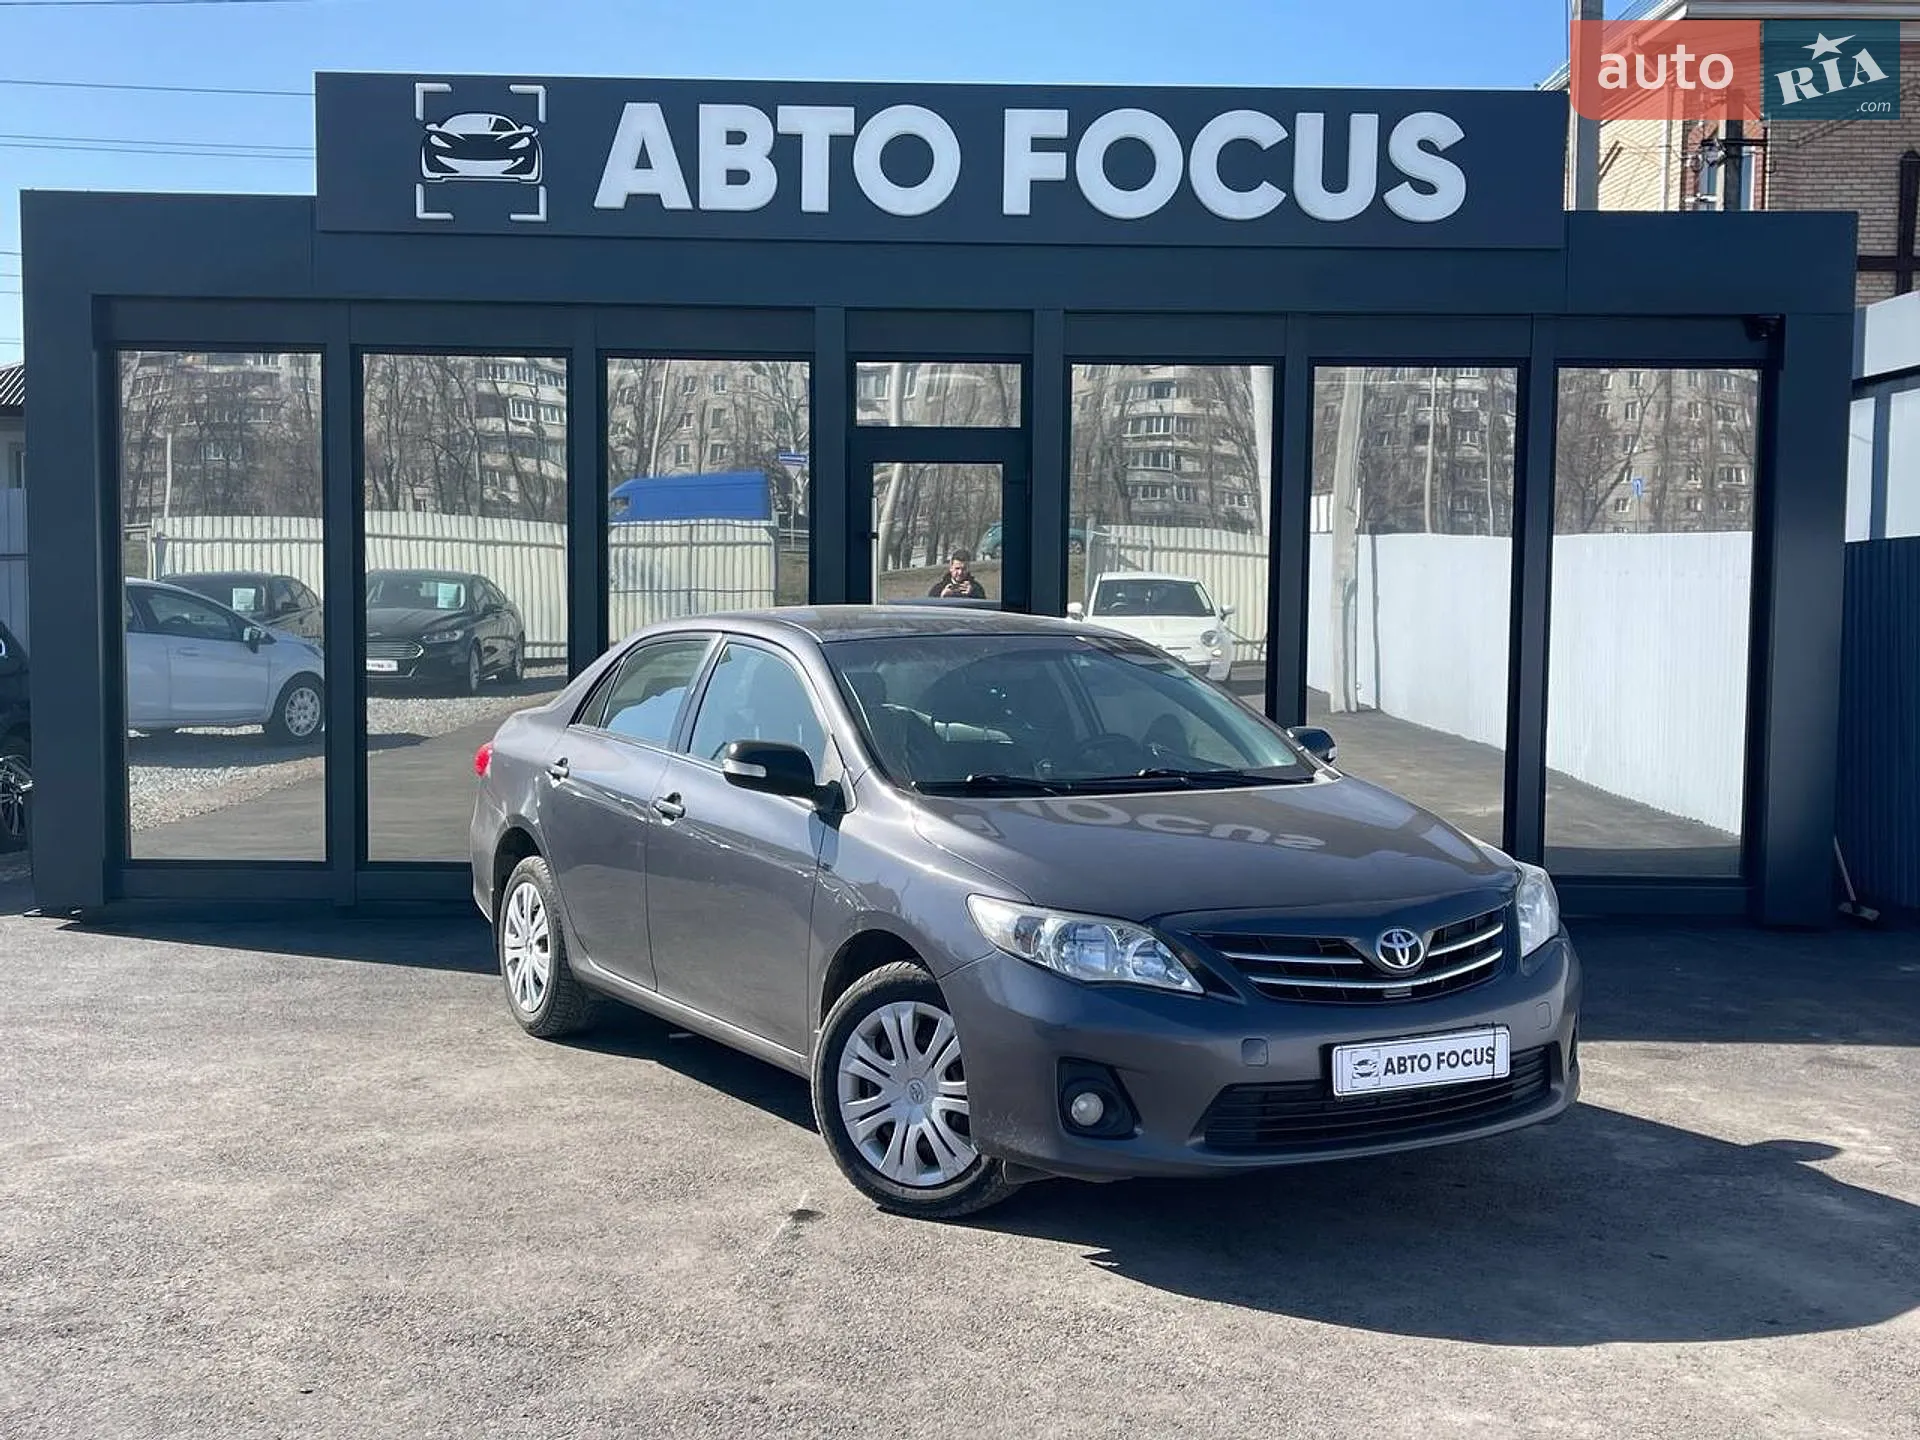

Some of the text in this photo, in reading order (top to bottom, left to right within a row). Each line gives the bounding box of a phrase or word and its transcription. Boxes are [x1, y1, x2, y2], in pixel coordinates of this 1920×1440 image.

[593, 102, 1466, 222] АВТО FOCUS
[1383, 1046, 1495, 1077] АВТО FOCUS
